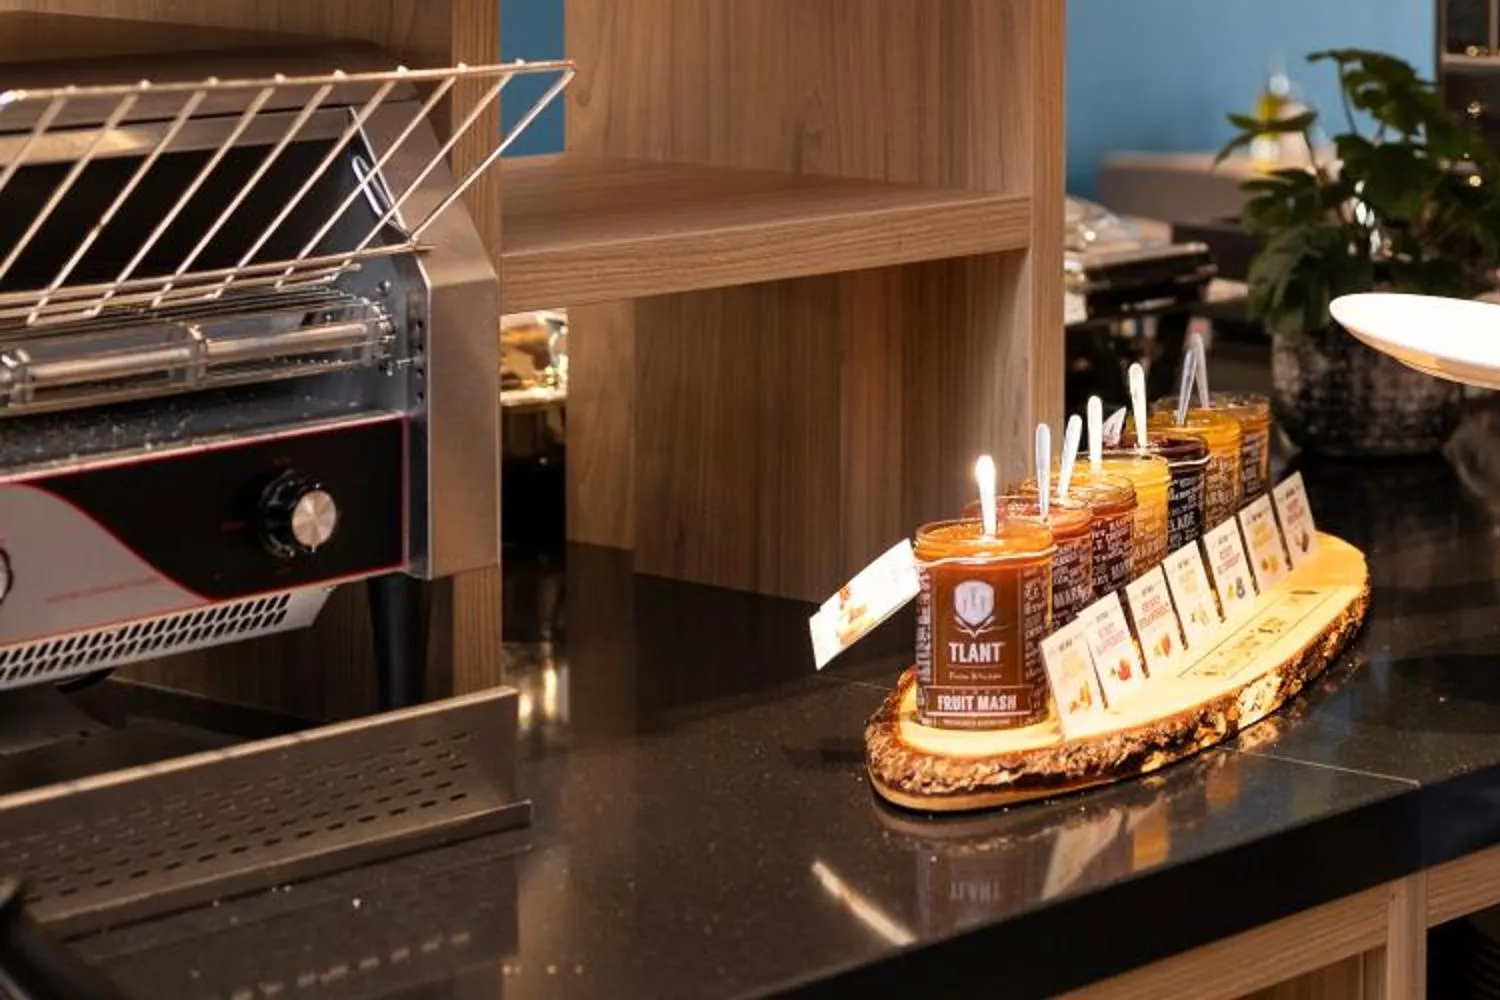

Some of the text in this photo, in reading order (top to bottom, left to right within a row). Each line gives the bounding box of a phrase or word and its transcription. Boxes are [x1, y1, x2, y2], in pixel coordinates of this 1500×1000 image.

[948, 641, 1006, 663] TLANT
[937, 695, 974, 711] FRUIT
[977, 695, 1017, 711] MASH
